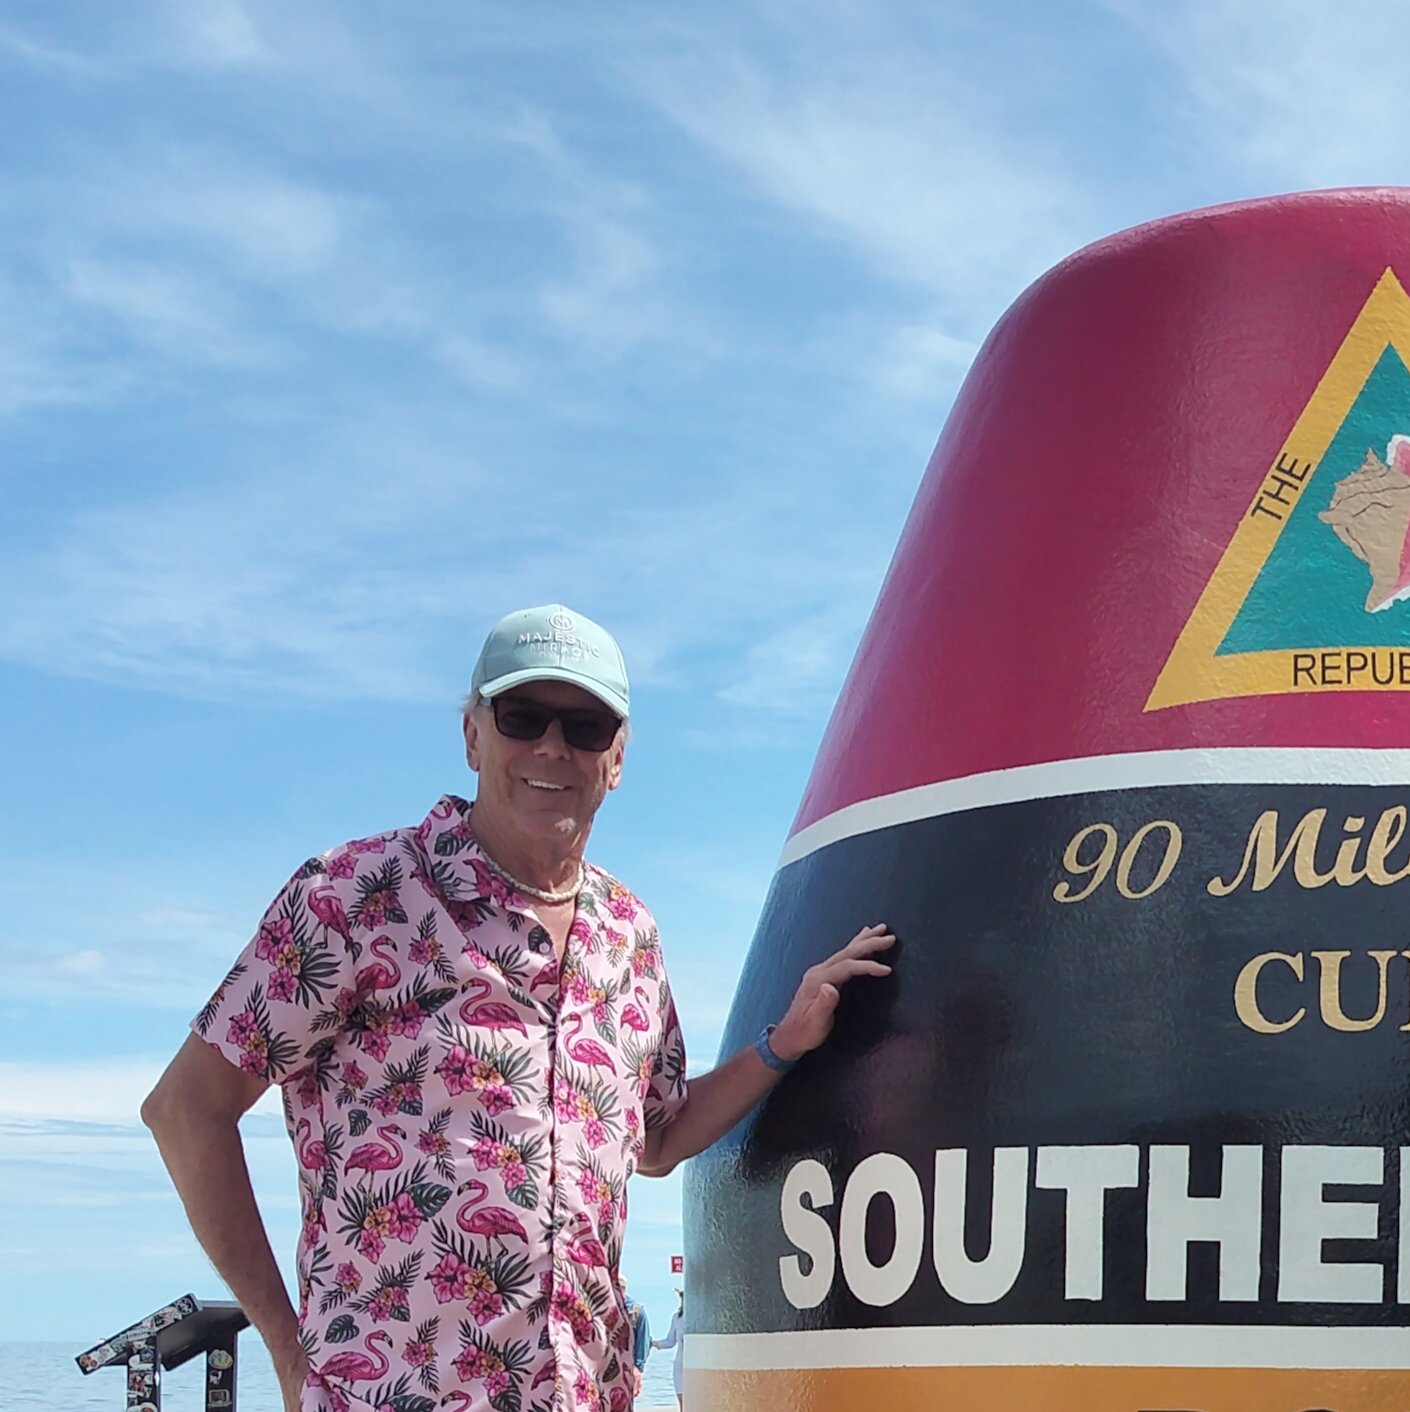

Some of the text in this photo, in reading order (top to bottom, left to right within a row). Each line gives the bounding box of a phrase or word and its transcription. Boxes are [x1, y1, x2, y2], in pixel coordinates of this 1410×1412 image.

[1251, 452, 1311, 521] THE
[518, 630, 600, 658] MAJESTIC
[1053, 820, 1182, 903] 90
